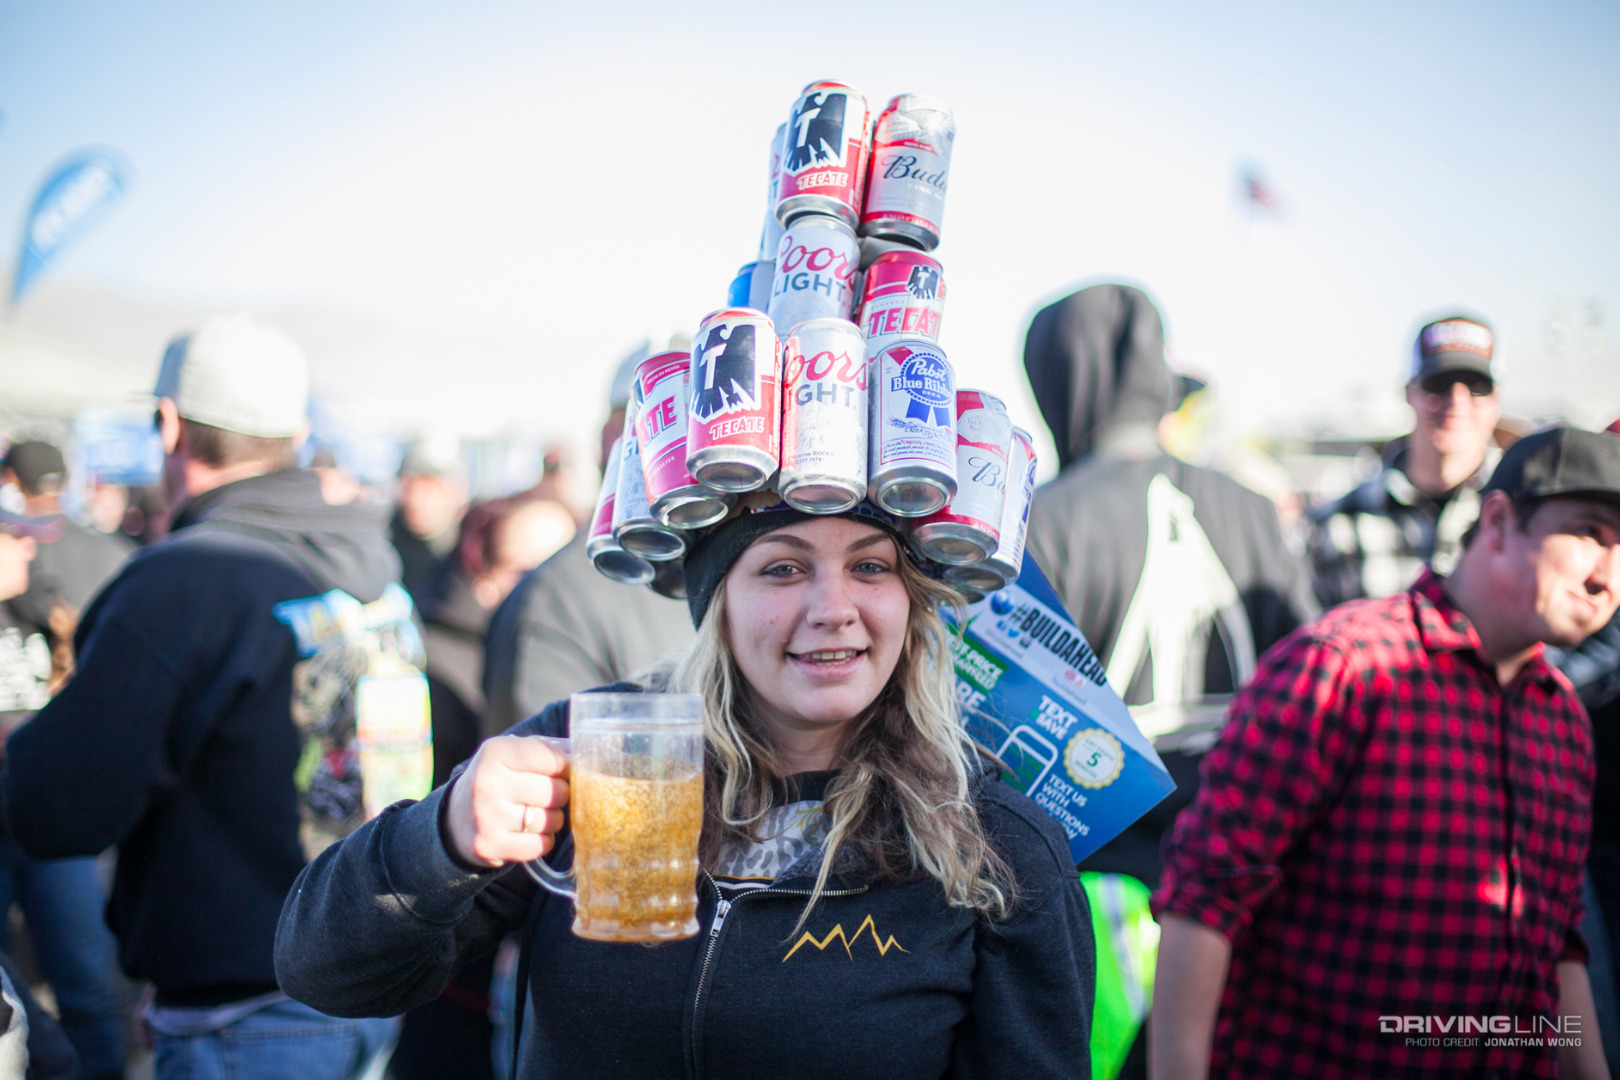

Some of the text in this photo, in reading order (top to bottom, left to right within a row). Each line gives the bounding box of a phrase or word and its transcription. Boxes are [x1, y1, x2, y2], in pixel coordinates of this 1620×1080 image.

[798, 171, 848, 189] TECATE
[774, 272, 846, 303] LIGHT
[892, 376, 922, 391] Blue
[910, 358, 947, 382] Pabst
[922, 389, 941, 399] BEER
[710, 416, 764, 440] TECATE
[1008, 603, 1107, 687] #BUILDAHEAD
[967, 649, 1003, 680] PRICE
[1038, 694, 1078, 729] TEXT
[1035, 712, 1069, 740] SAVE
[1086, 752, 1102, 767] 5
[1042, 782, 1070, 808] WITH
[1048, 773, 1074, 796] TEXT
[1071, 791, 1088, 808] US
[1034, 791, 1091, 836] QUESTIONS
